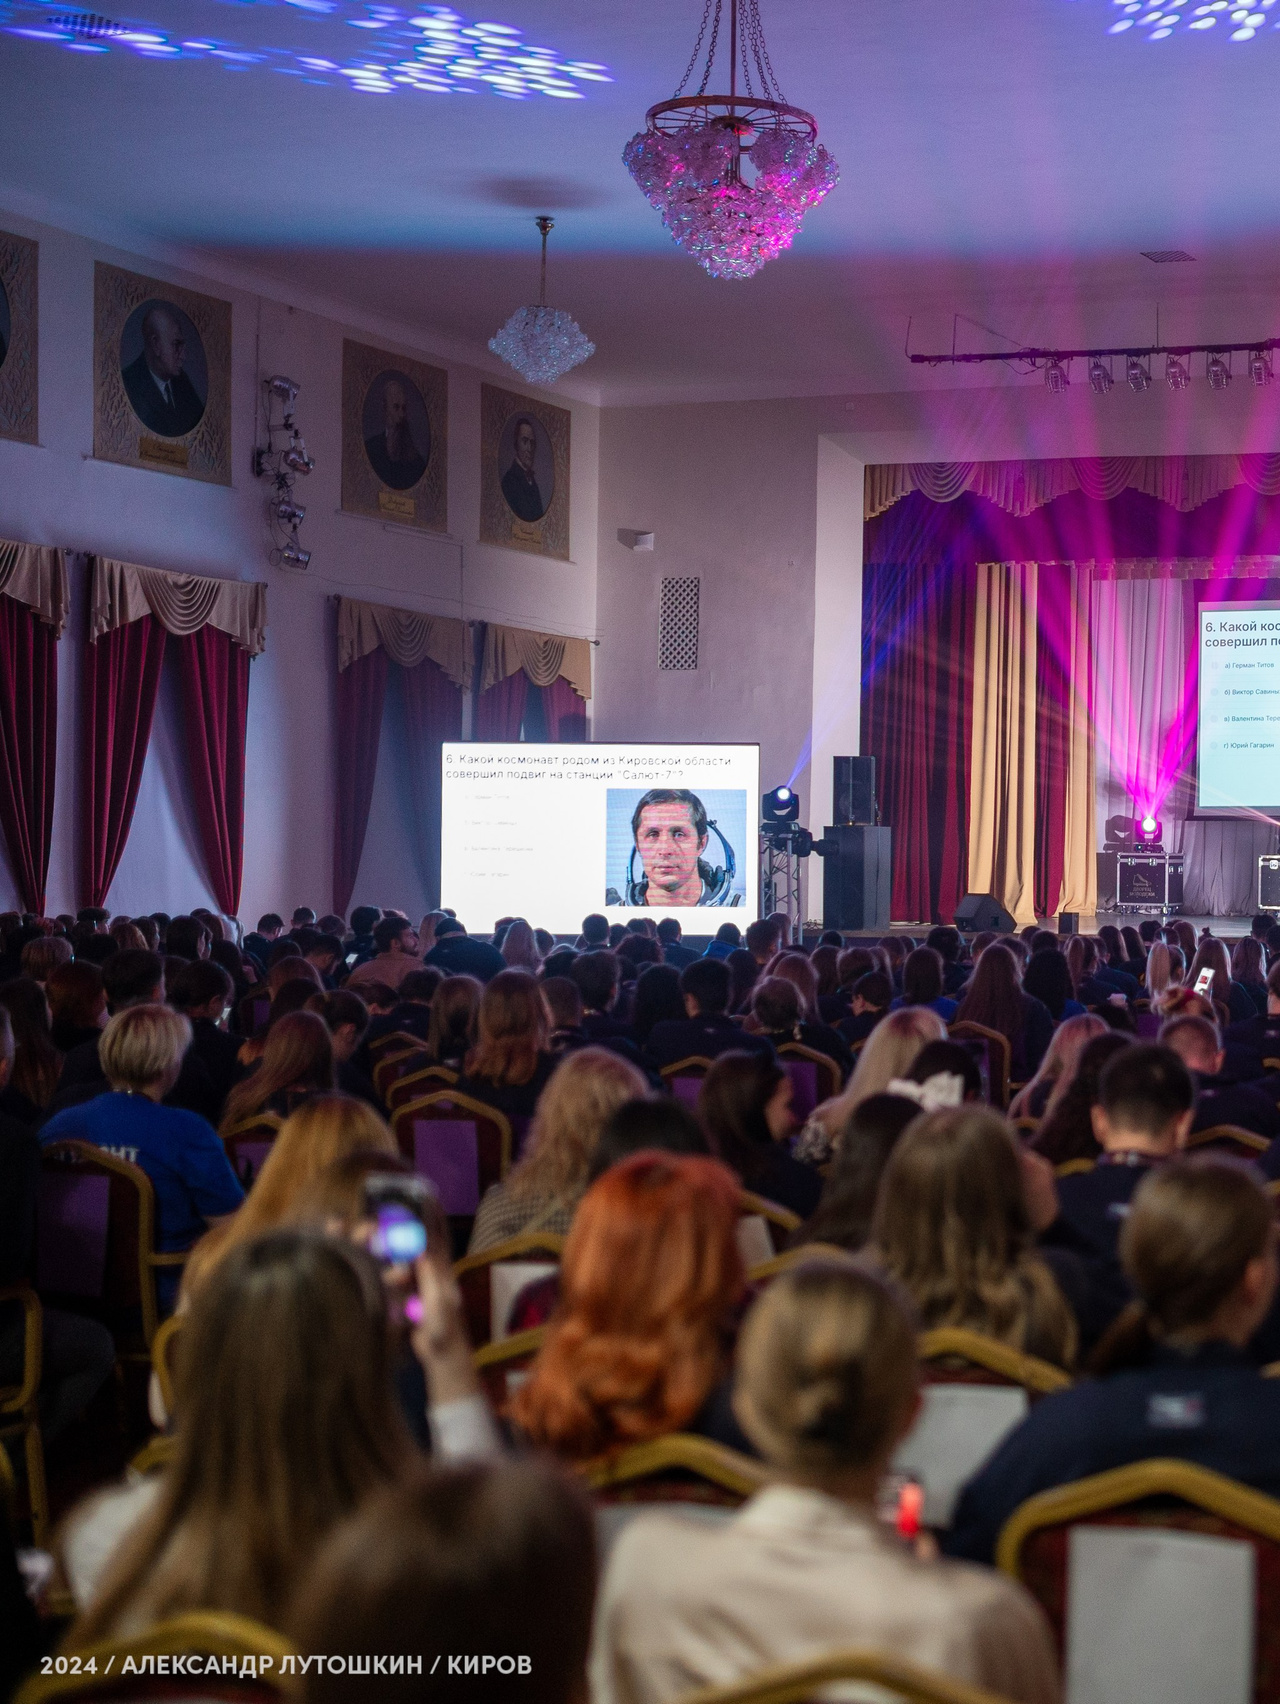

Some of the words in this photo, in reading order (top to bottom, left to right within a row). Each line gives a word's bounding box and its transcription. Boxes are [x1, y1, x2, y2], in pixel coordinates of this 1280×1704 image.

[1205, 621, 1217, 633] 6.
[1220, 619, 1257, 632] Какой
[1205, 637, 1268, 650] совершил
[1231, 661, 1255, 669] Герман
[1256, 660, 1275, 668] Титов
[1231, 687, 1254, 696] Виктор
[1231, 714, 1265, 723] Валентина
[1230, 740, 1248, 750] Юрий
[1249, 741, 1275, 750] Гагарин
[459, 753, 494, 765] Какой
[497, 756, 559, 765] космонавт
[562, 756, 600, 767] родом
[618, 756, 681, 767] Кировской
[684, 757, 731, 766] области
[446, 770, 504, 781] совершил
[507, 770, 547, 780] подвиг
[550, 771, 563, 780] на
[566, 771, 614, 781] станции
